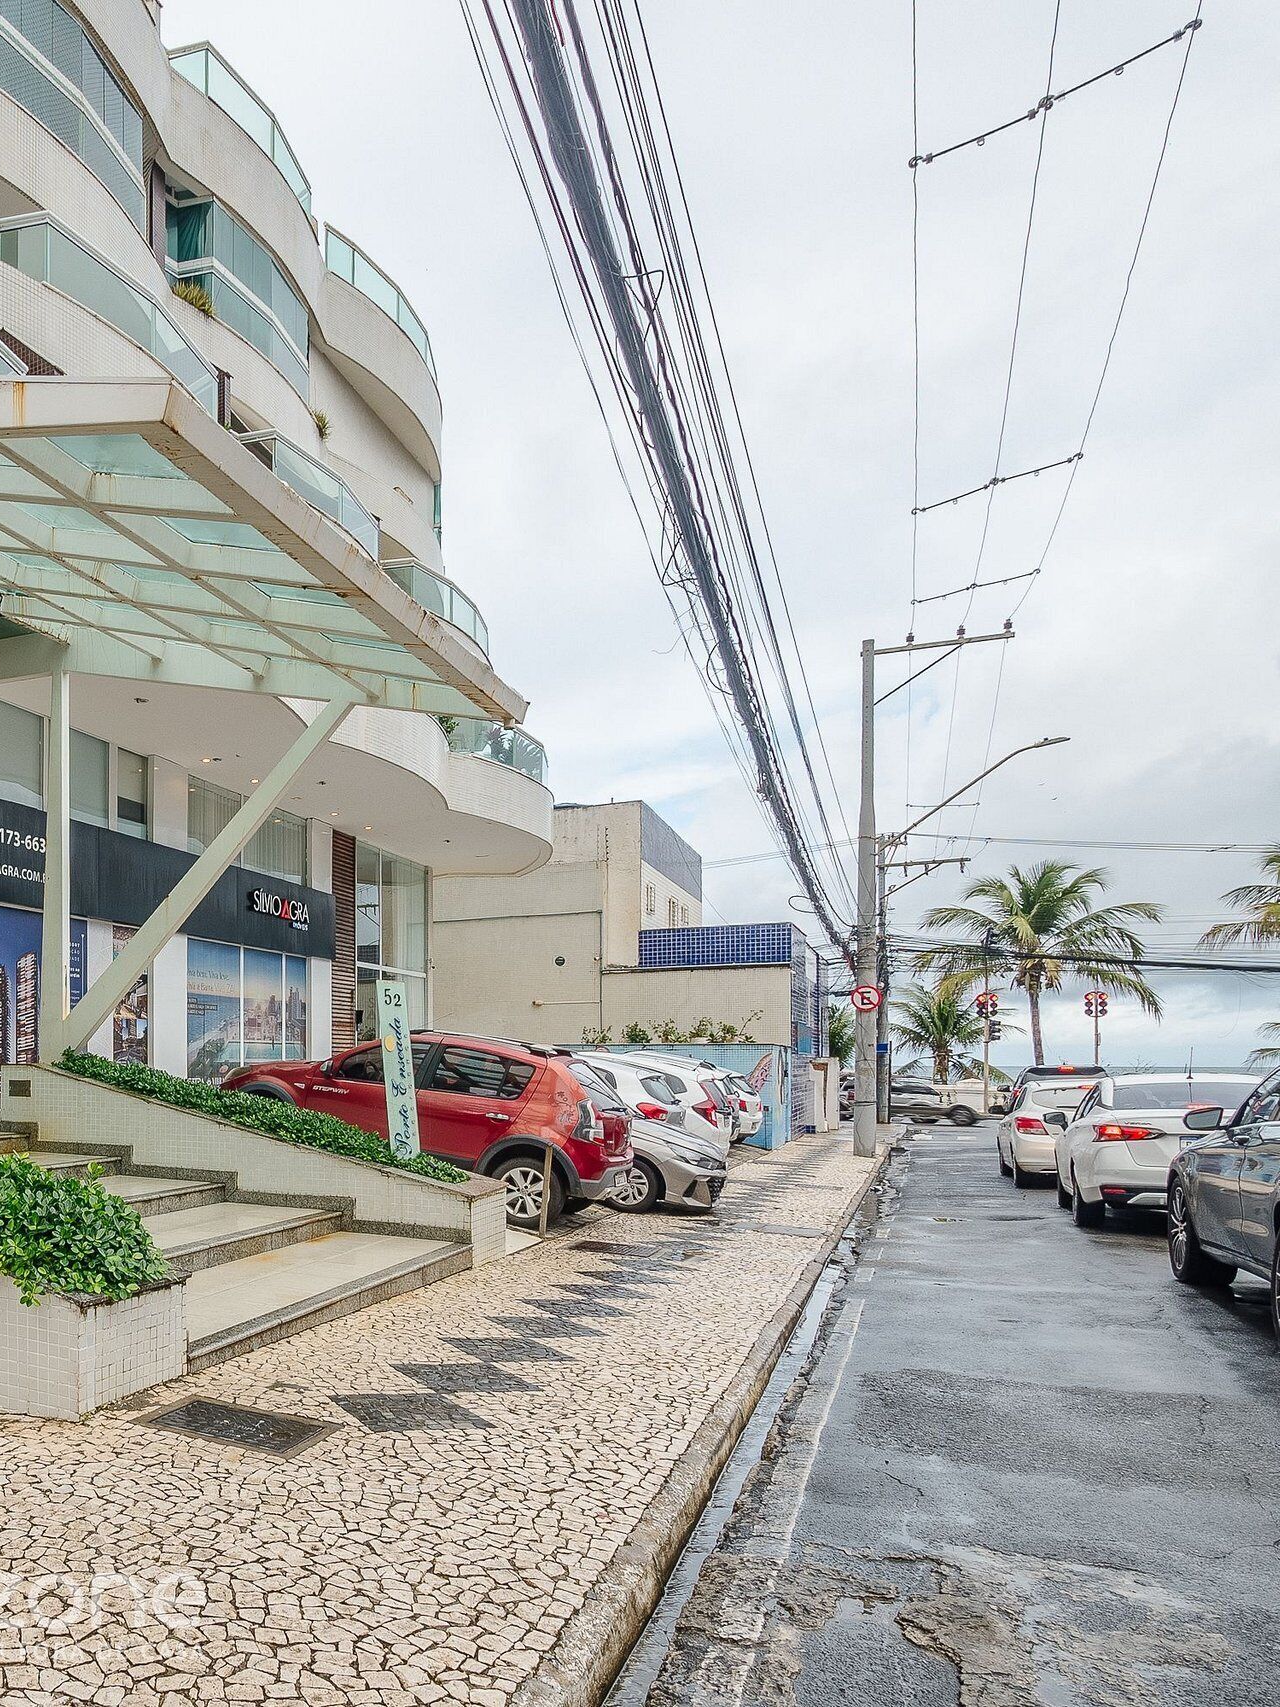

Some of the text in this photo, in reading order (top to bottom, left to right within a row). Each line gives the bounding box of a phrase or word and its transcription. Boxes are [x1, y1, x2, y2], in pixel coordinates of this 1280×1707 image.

[384, 988, 402, 1007] 52
[861, 991, 872, 1006] E
[394, 1103, 412, 1155] Porto
